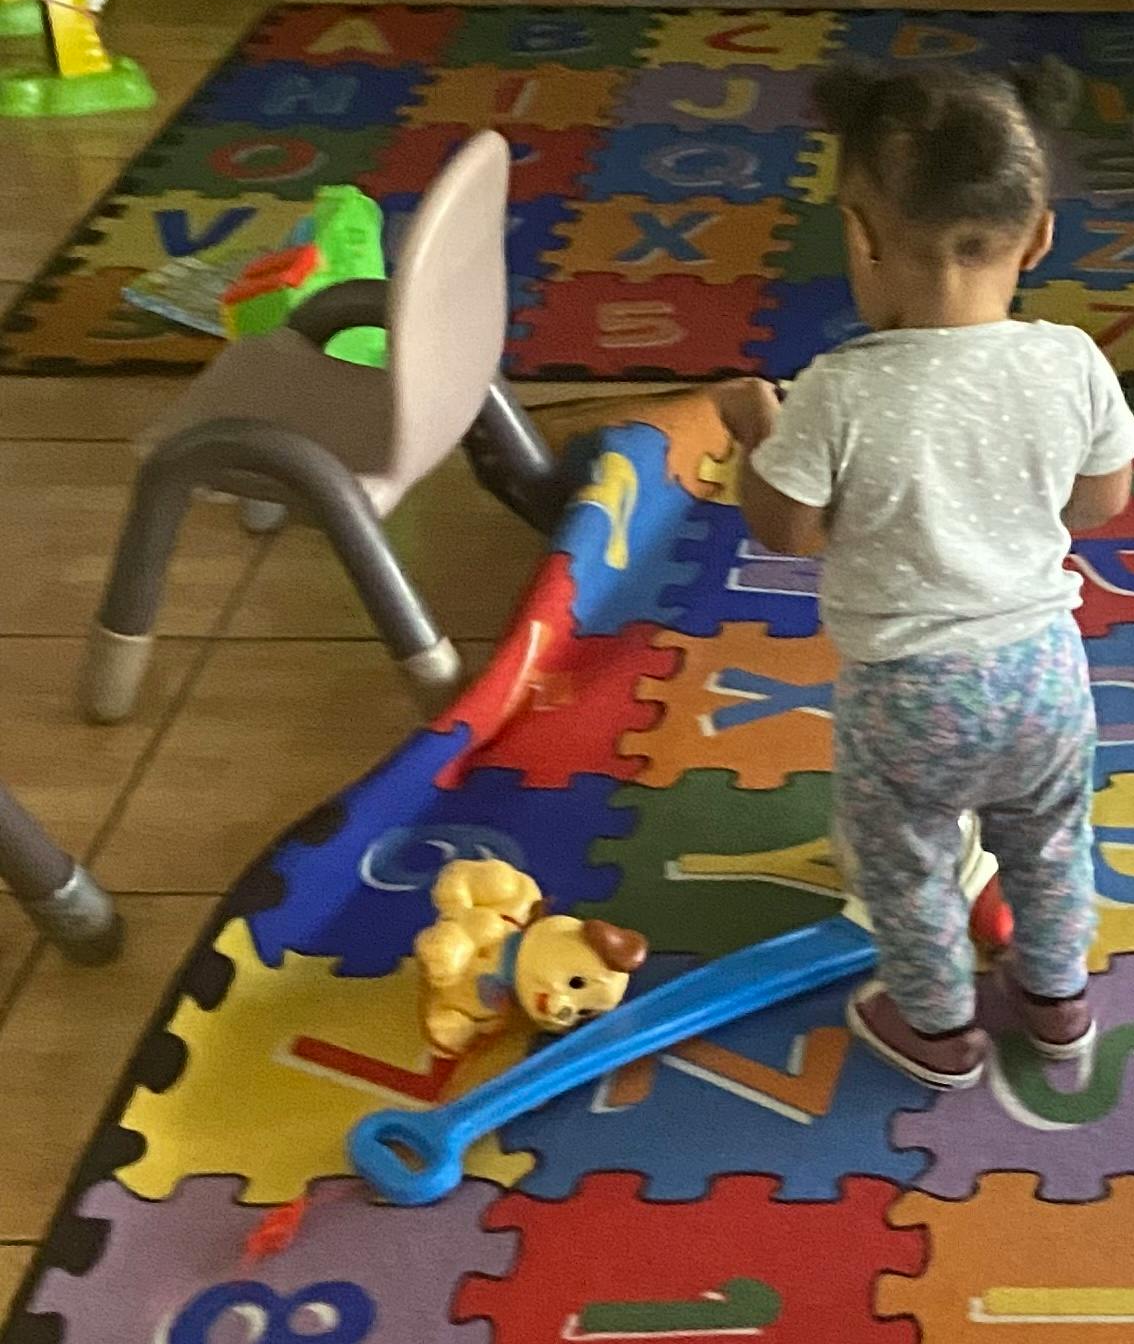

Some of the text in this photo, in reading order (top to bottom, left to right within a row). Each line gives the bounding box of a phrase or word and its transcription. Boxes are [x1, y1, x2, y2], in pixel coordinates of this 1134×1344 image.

[304, 16, 394, 55] A
[511, 18, 598, 56] B
[705, 21, 782, 54] C
[892, 24, 984, 59] D
[262, 74, 362, 116] H
[672, 77, 762, 119] J
[208, 136, 328, 182] O
[643, 142, 762, 190] Q
[153, 207, 260, 257] V
[613, 211, 720, 265] X
[562, 1276, 782, 1342] 1
